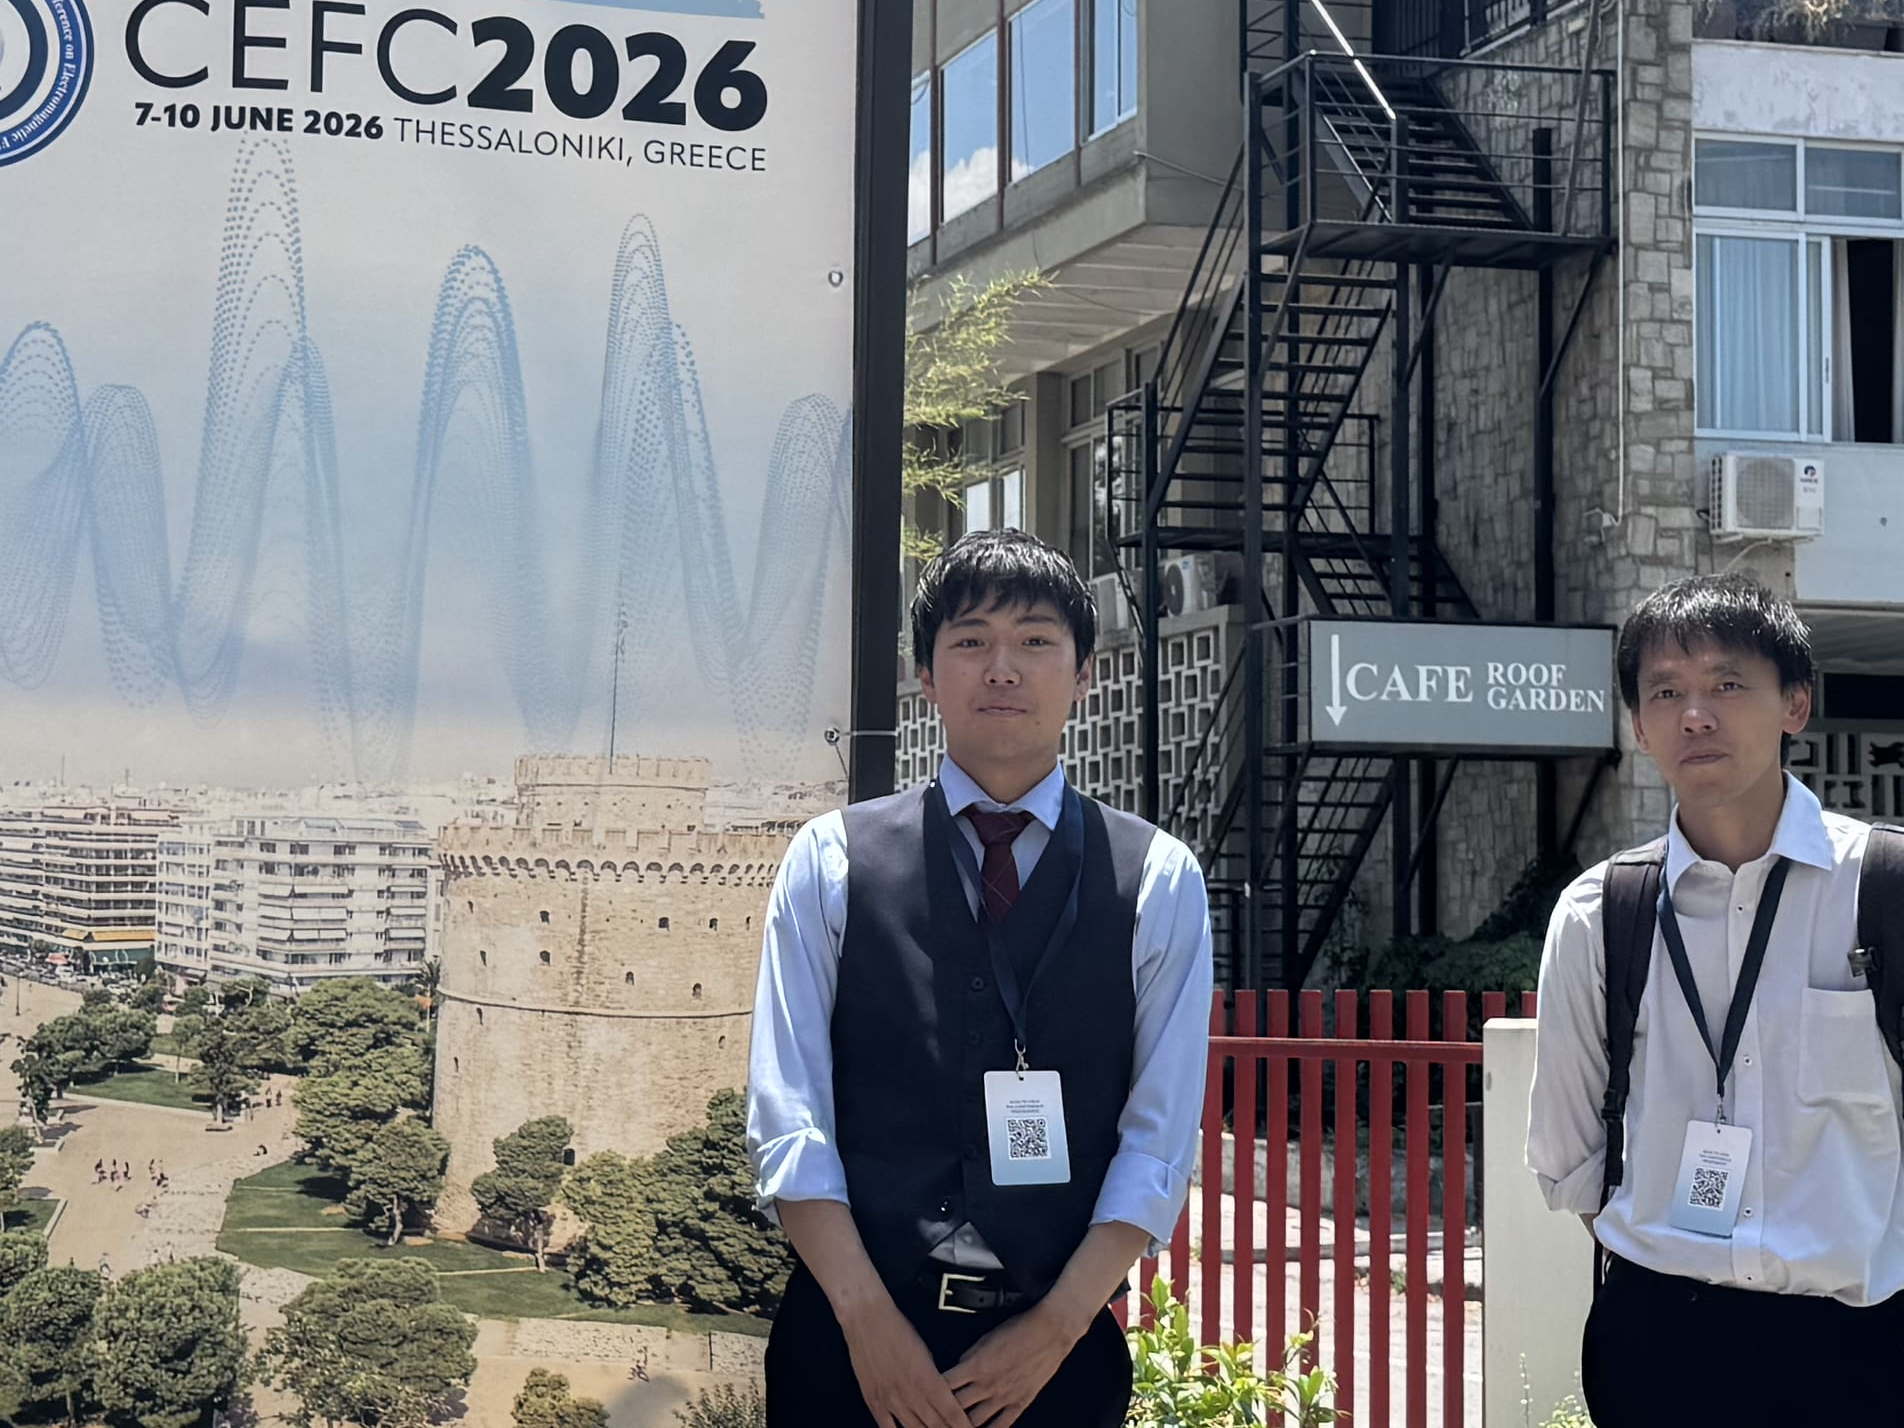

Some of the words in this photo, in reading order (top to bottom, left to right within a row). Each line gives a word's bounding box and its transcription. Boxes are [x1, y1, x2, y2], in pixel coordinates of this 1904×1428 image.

[63, 43, 75, 60] on
[134, 102, 201, 129] 7-10
[210, 104, 294, 133] JUNE
[303, 108, 384, 140] 2026
[393, 117, 633, 167] THESSALONIKI,
[643, 139, 767, 171] GREECE
[1345, 662, 1474, 703] CAFE
[1487, 662, 1567, 687] ROOF
[1487, 686, 1606, 713] GARDEN
